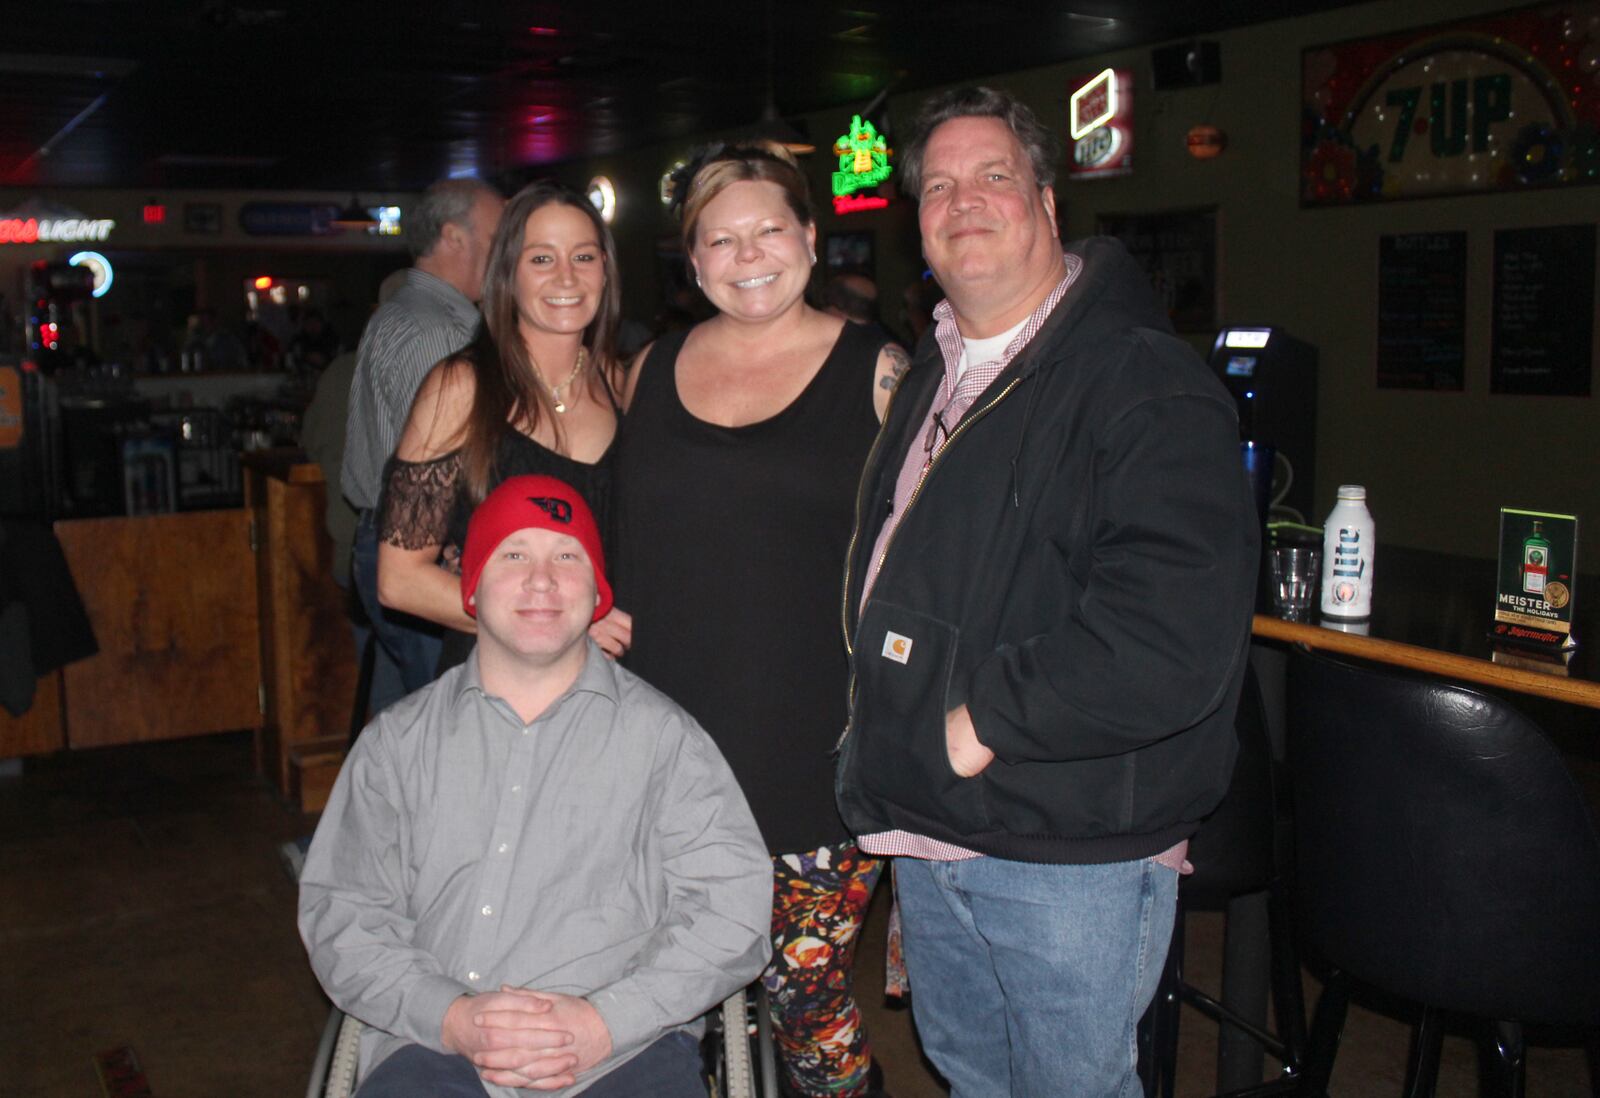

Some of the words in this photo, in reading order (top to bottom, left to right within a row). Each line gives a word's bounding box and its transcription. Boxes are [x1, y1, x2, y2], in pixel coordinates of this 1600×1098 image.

[38, 219, 115, 243] LIGHT
[1333, 528, 1365, 579] Lite
[1498, 593, 1552, 611] MEISTER
[1513, 605, 1525, 613] THE
[1526, 608, 1559, 619] HOLIDAYS
